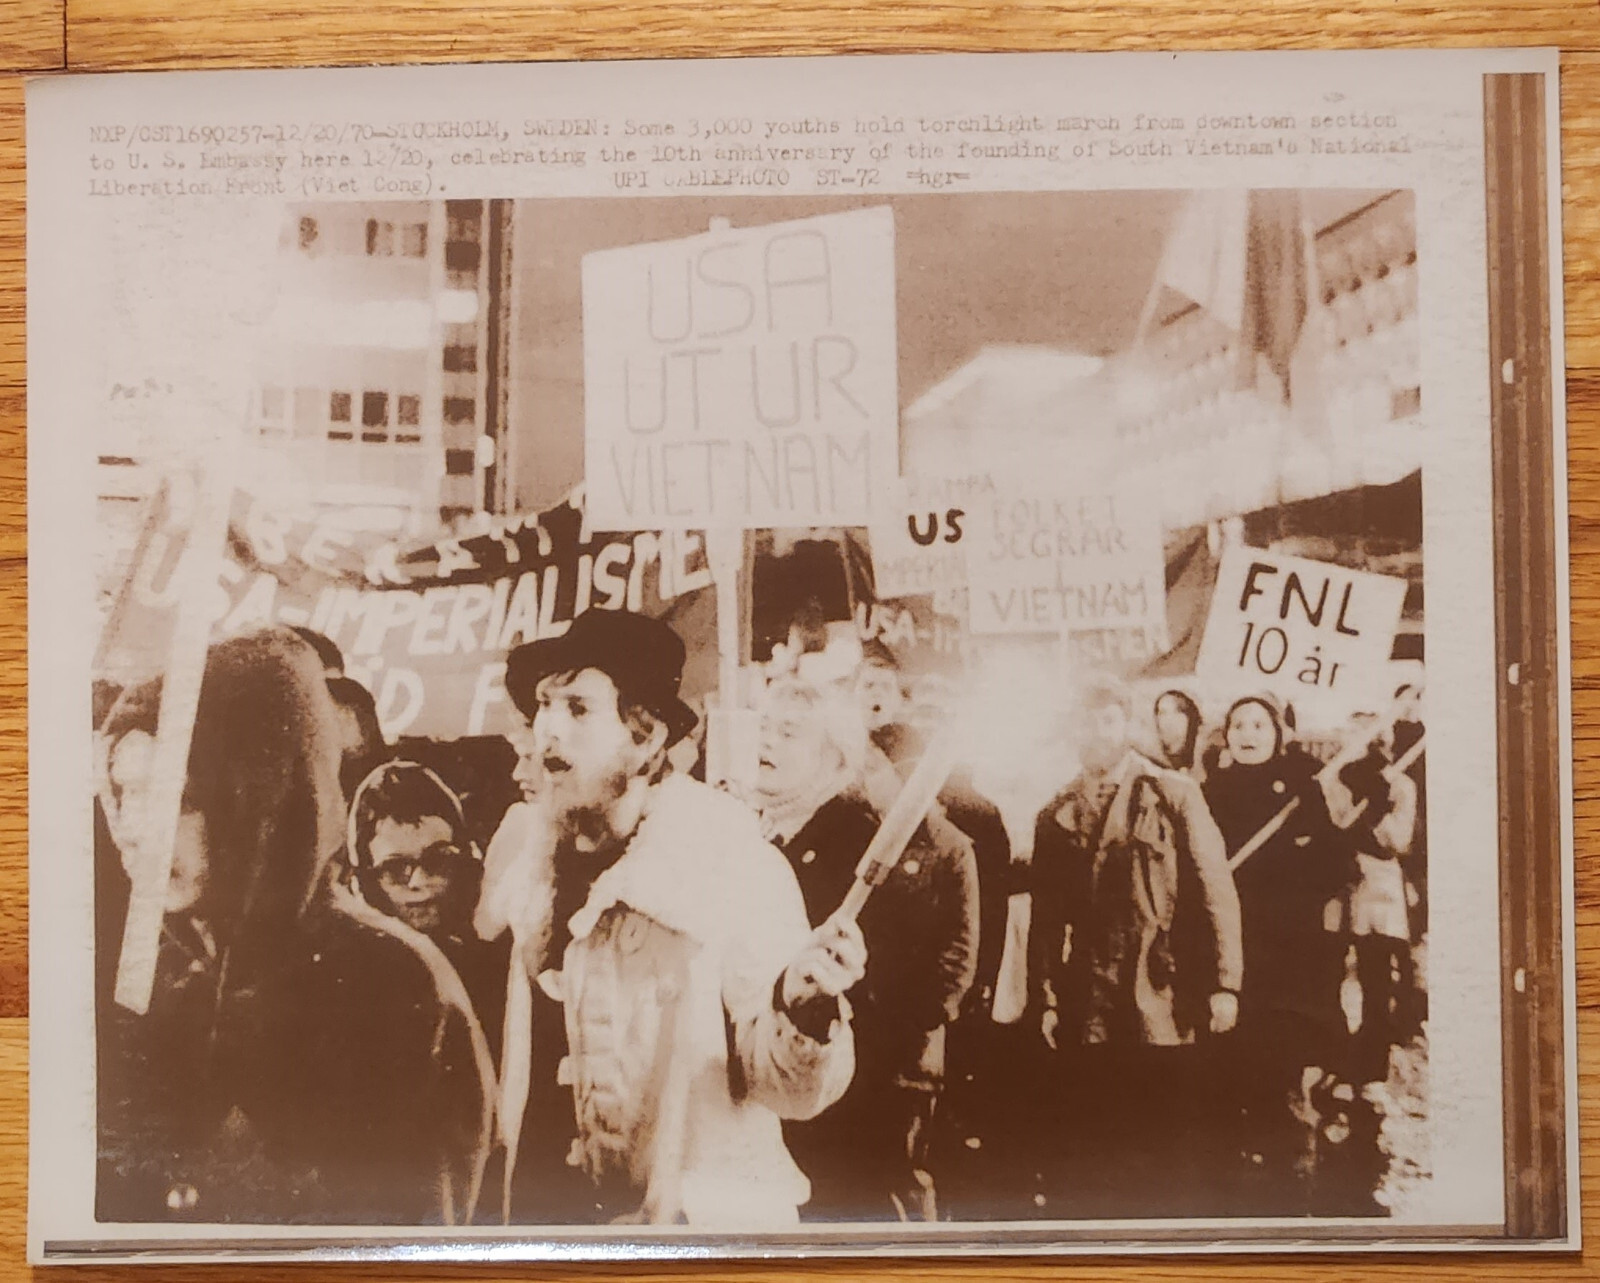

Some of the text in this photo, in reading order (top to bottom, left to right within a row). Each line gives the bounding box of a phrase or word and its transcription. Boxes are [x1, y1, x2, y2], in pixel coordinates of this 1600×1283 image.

[624, 118, 675, 137] Some
[688, 118, 753, 140] 3,000
[764, 118, 840, 139] youths
[855, 115, 904, 133] hold
[920, 114, 1043, 135] torchlight
[1056, 114, 1121, 132] march
[1134, 113, 1185, 131] from
[1197, 113, 1297, 130] downtown
[1311, 110, 1398, 129] section
[89, 152, 114, 171] to
[127, 153, 149, 170] U.
[163, 152, 185, 170] S.
[200, 151, 288, 173] Embassy
[300, 151, 350, 168] here
[451, 147, 586, 168] celebrating
[600, 146, 637, 163] the
[651, 143, 701, 162] 10th
[714, 142, 855, 164] anniversary
[869, 142, 893, 161] of
[908, 142, 944, 160] the
[957, 139, 1060, 162] founding
[1072, 139, 1098, 158] of
[1109, 138, 1173, 157] South
[1184, 137, 1298, 156] Vietnam's
[1310, 135, 1412, 154] National
[89, 172, 446, 197] Liberation Front (Viet Cong).
[613, 170, 649, 188] UPI
[816, 168, 880, 186] ST-72
[647, 227, 834, 344] USA
[623, 334, 870, 435] UT UR
[610, 429, 872, 518] VIETNAM
[907, 507, 967, 547] US
[987, 577, 1148, 622] VIETNAM
[1239, 562, 1360, 638] FNL
[1237, 622, 1348, 688] 10 år
